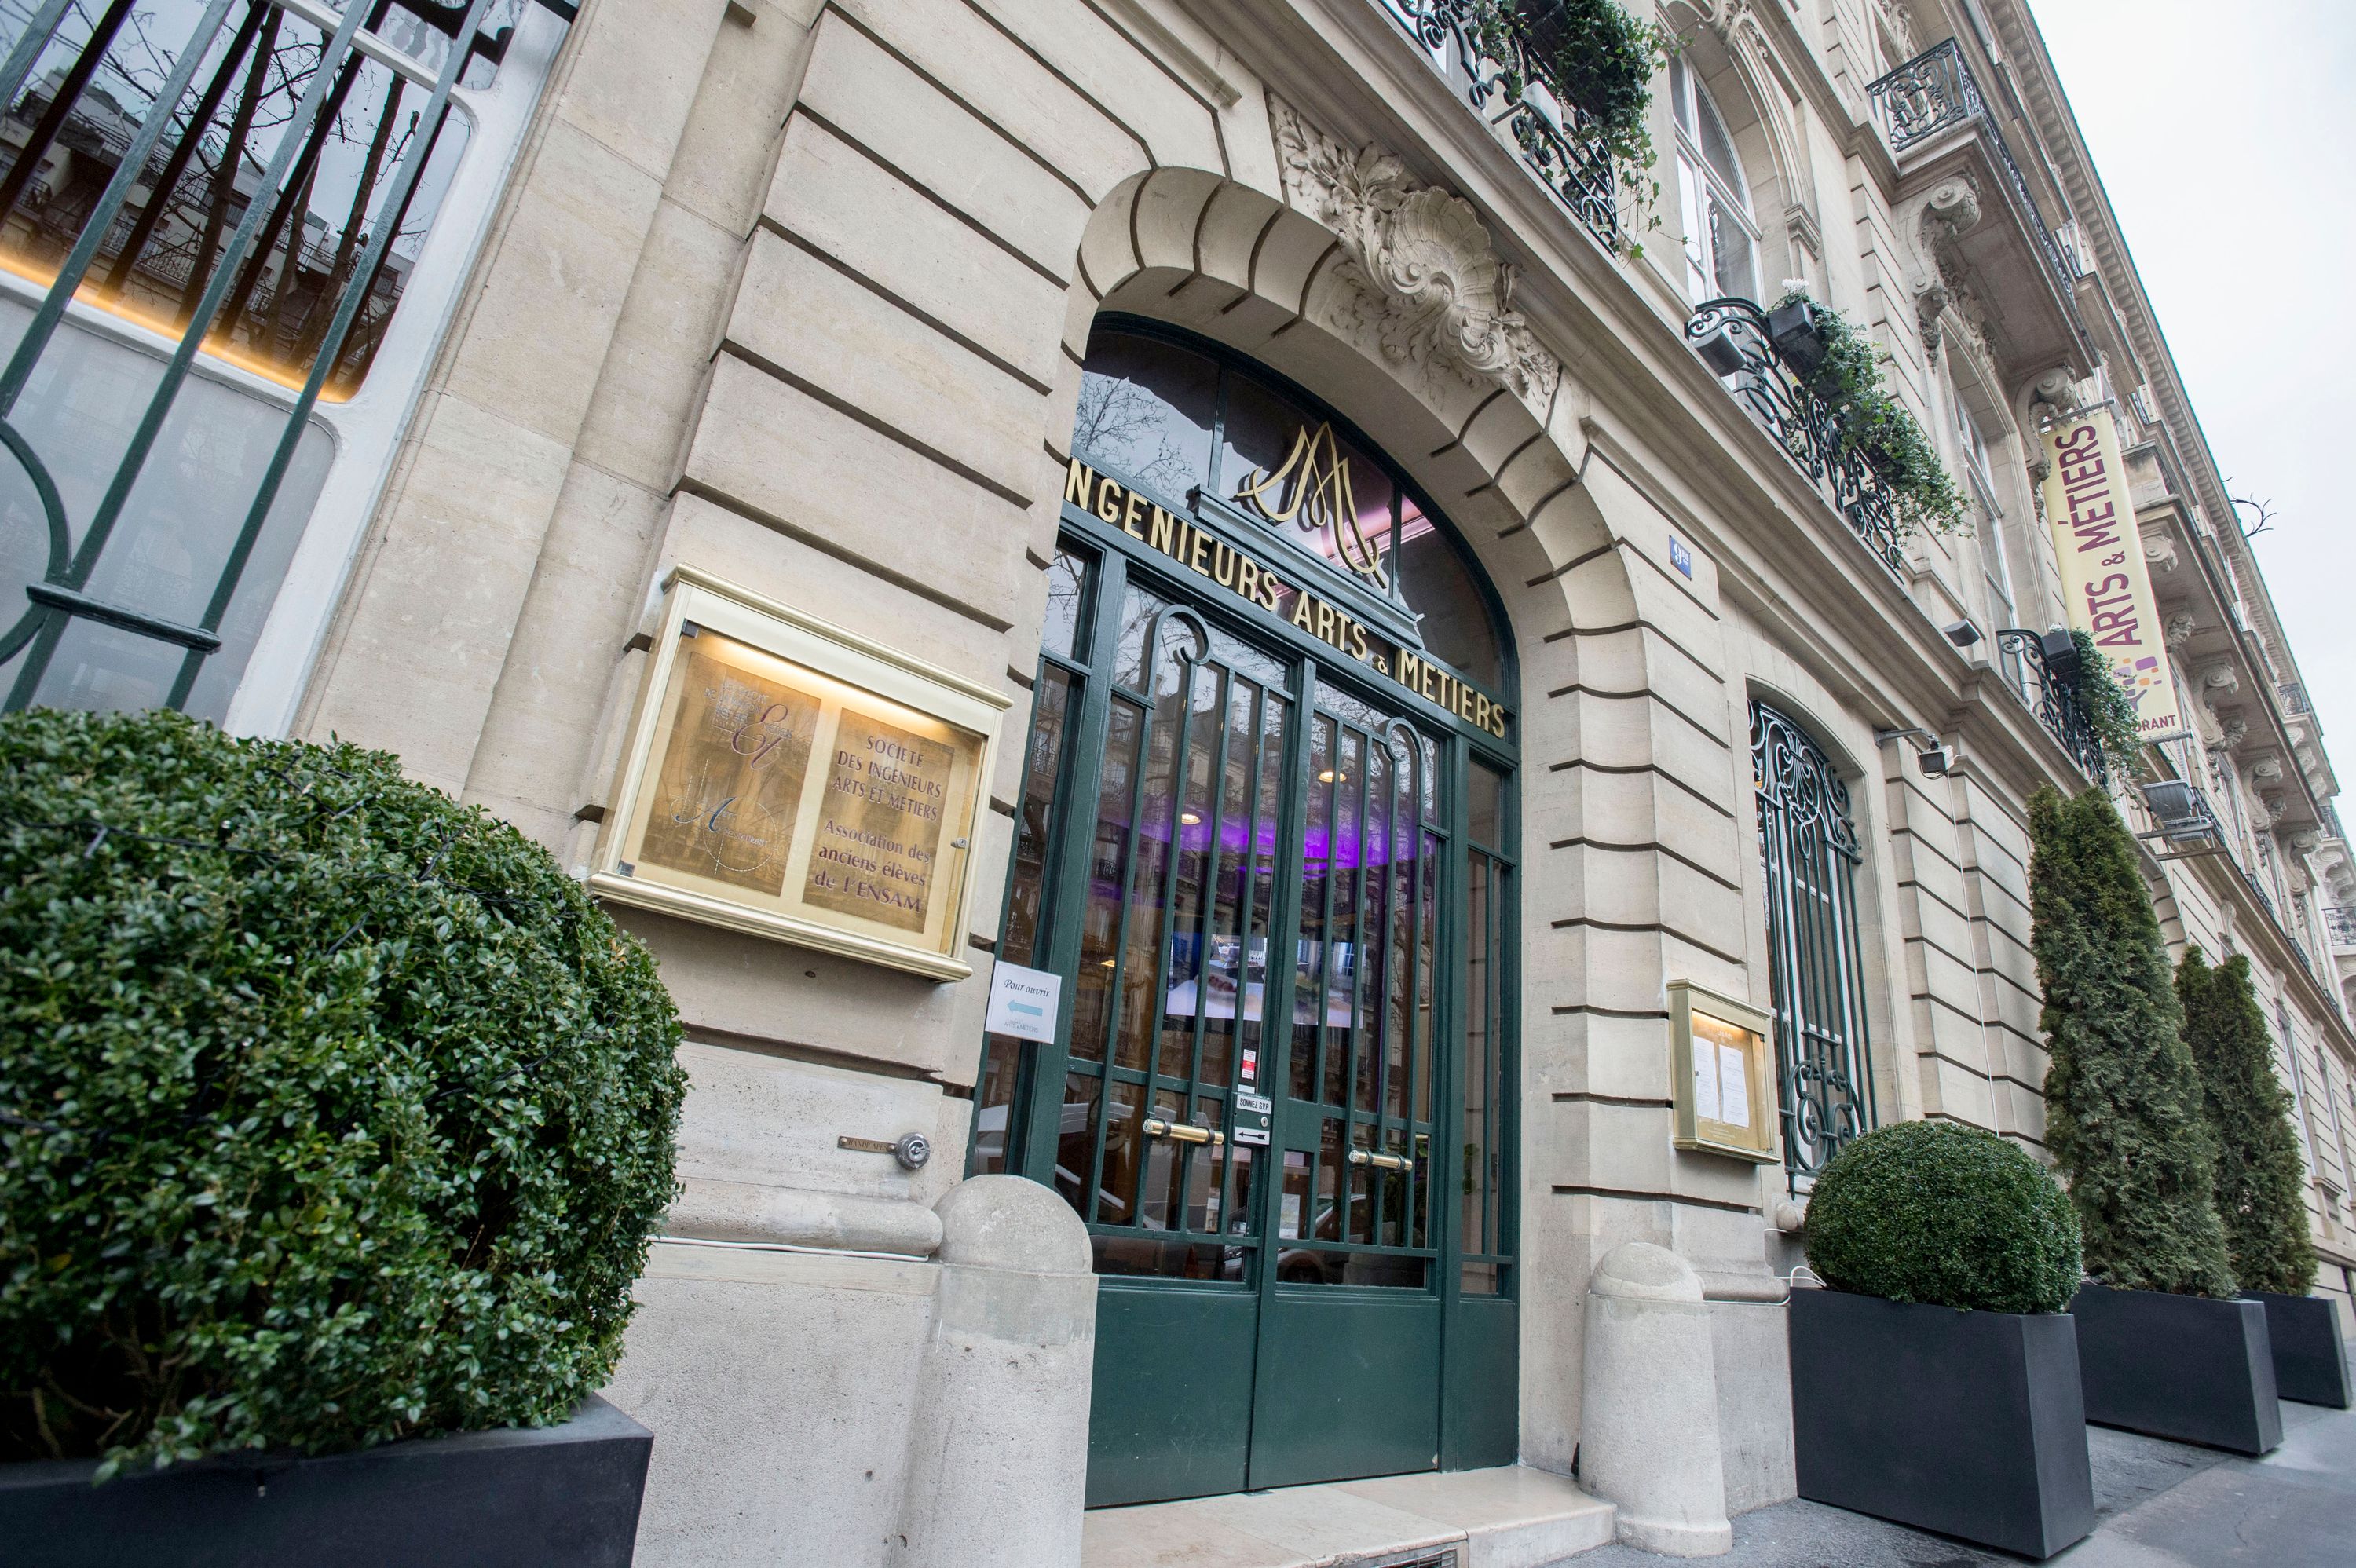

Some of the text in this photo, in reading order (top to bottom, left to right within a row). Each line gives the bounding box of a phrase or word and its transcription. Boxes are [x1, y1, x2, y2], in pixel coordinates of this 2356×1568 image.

[1674, 543, 1683, 565] 9
[2054, 426, 2142, 646] ARTS & MÉTIERS
[1066, 458, 1505, 739] NGENIEURS ARTS & METIERS
[2133, 715, 2175, 733] URANT
[866, 736, 924, 768] SOCIETE
[837, 750, 941, 799] DES INGENIEURS
[832, 776, 938, 821] ARTS ET METIERS
[824, 820, 931, 863] Association des
[818, 846, 925, 886] anciens élèves
[814, 869, 921, 912] de l'ENSAM
[1004, 979, 1051, 997] Pour ouvrir
[1239, 1098, 1258, 1109] SONNEZ
